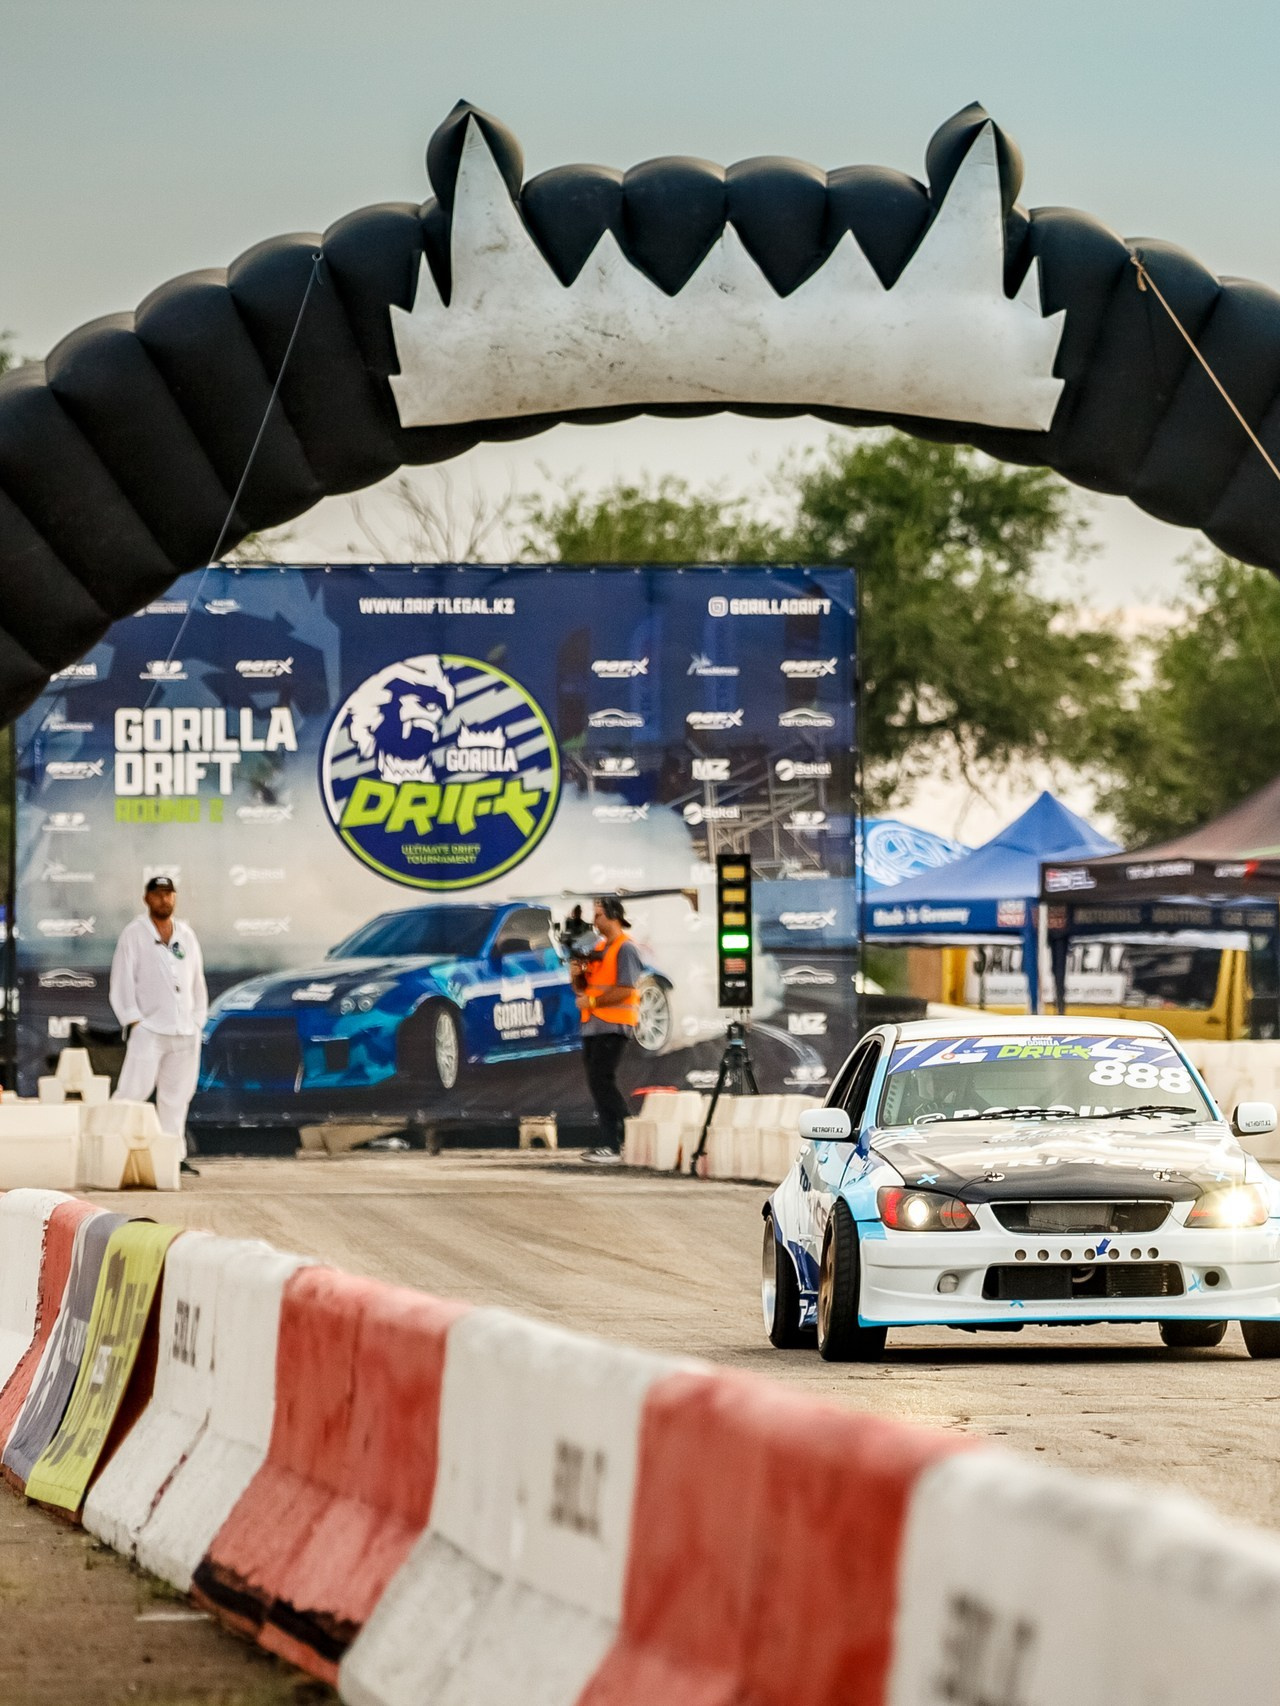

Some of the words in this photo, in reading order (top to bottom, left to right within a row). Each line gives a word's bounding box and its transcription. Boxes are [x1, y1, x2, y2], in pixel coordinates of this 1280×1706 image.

[359, 597, 516, 615] WWW.DRIFTLEGAL.KZ
[114, 707, 298, 752] GORILLA
[114, 752, 242, 796] DRIFT
[446, 748, 519, 772] GORILLA
[340, 777, 542, 838] DRIFT
[493, 999, 545, 1032] GORILLA
[996, 1045, 1092, 1060] DRIFT
[1088, 1060, 1192, 1094] 888
